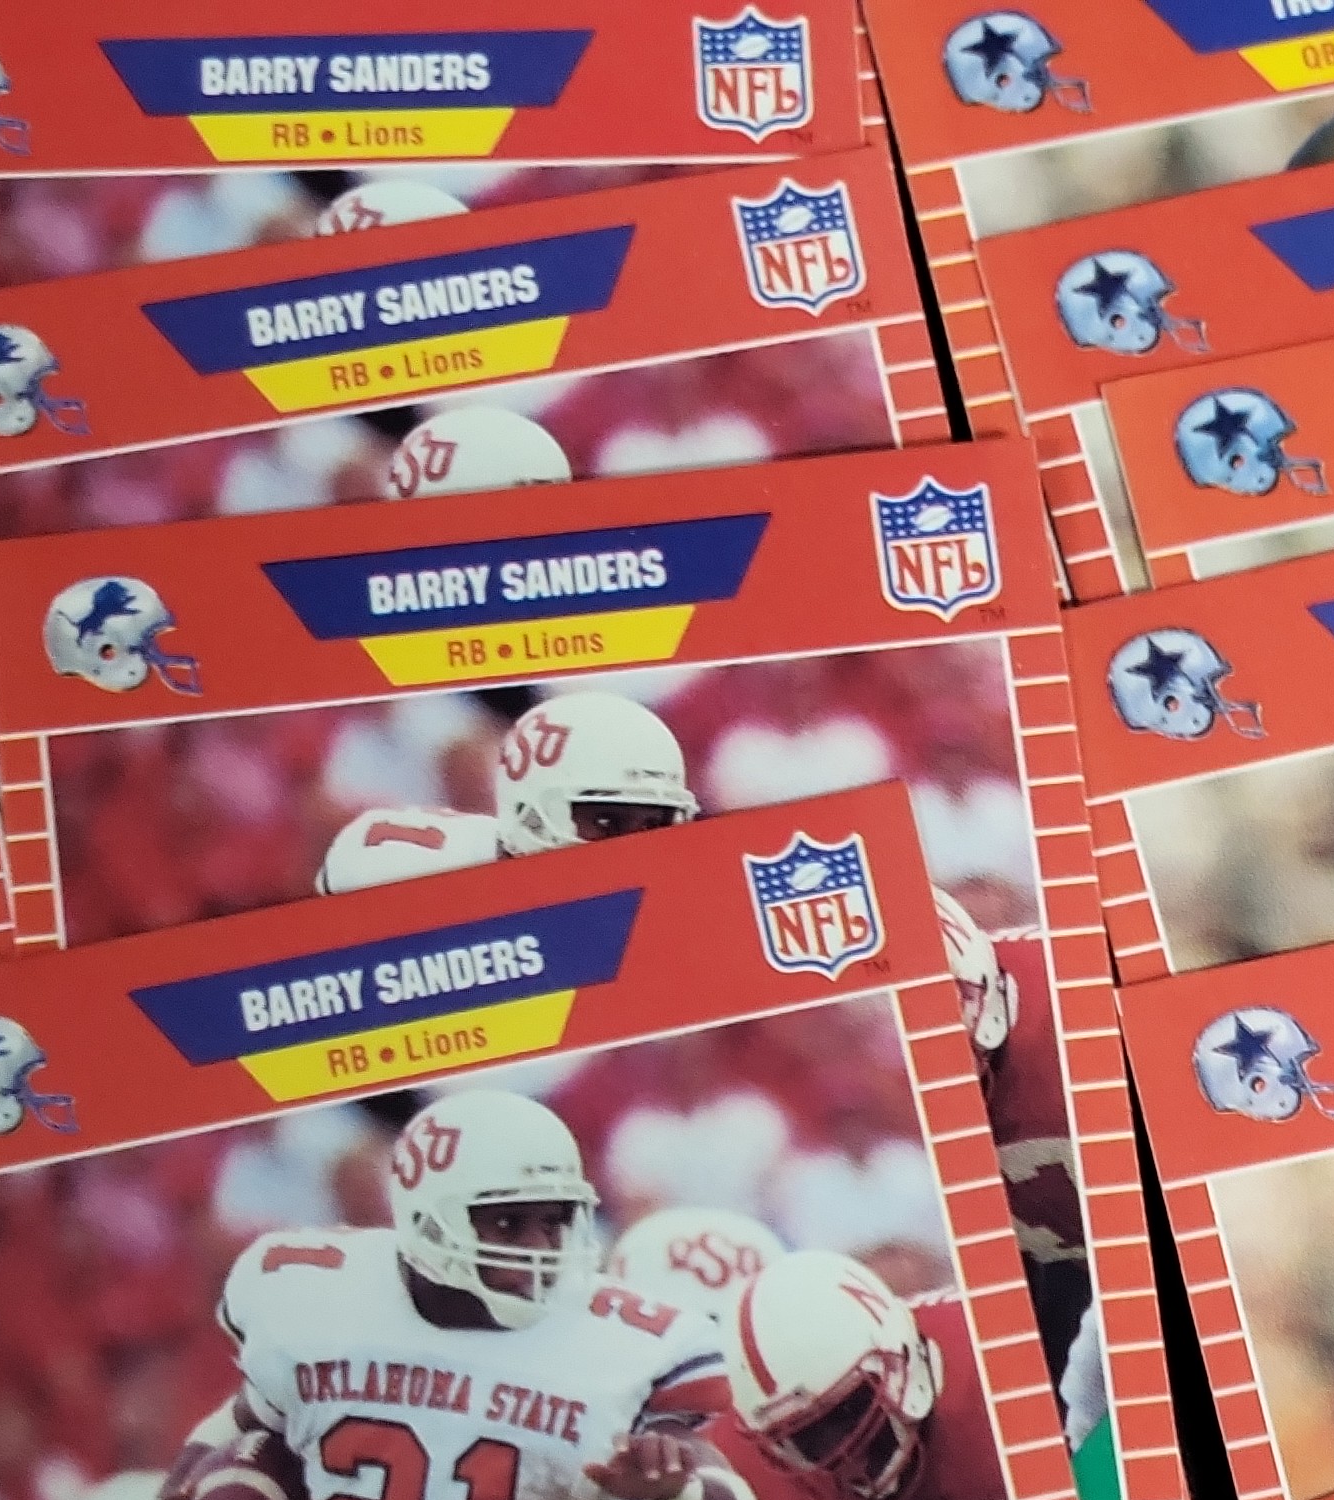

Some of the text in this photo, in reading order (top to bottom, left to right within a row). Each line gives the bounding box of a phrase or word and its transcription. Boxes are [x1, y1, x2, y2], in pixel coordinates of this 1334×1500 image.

[200, 52, 491, 96] BARRY SANDERS
[709, 67, 798, 119] NFL
[271, 121, 424, 148] RB Lions
[758, 236, 852, 294] NFL
[246, 264, 540, 347] BARRY SANDERS
[329, 347, 483, 391] RB Lions
[367, 547, 667, 615] BARRY SANDERS
[892, 541, 986, 600] NFL
[446, 632, 604, 667] RB Lions
[770, 892, 870, 958] NFL
[240, 935, 544, 1032] BARRY SANDERS
[326, 1026, 488, 1078] RB Lions
[294, 1358, 588, 1447] OKLAHOMA STATE
